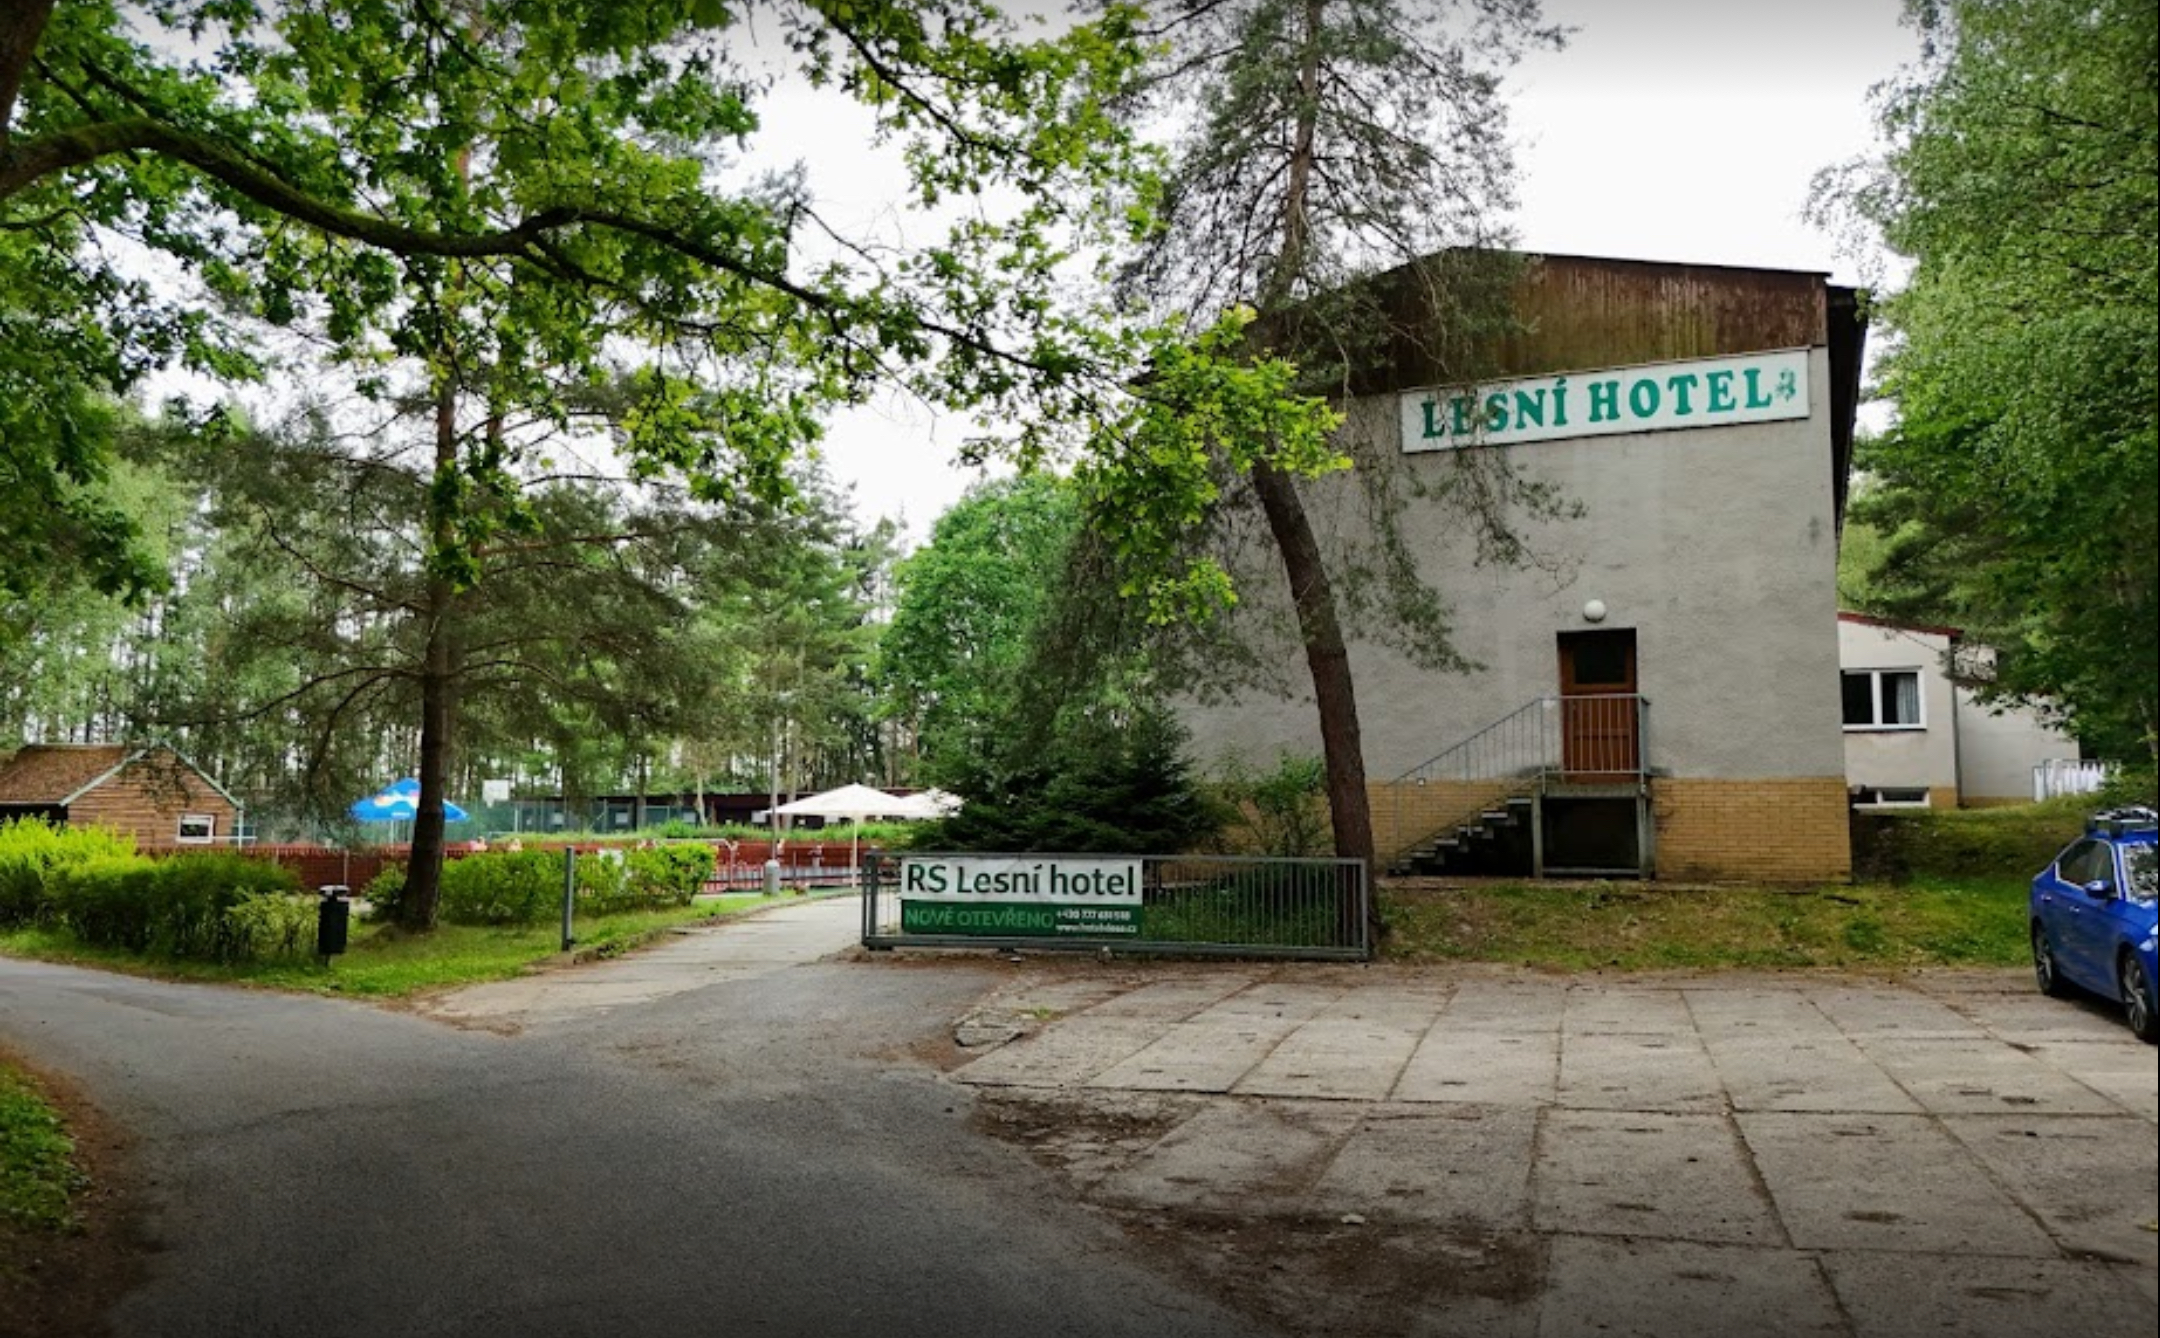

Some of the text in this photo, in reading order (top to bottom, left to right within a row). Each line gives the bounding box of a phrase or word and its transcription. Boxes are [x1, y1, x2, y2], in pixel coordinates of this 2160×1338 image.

[1420, 367, 1772, 439] LESNÍ HOTEL
[907, 864, 1135, 896] RS Lesní hotel
[905, 906, 1054, 928] NOVĚ OTEVŘENO
